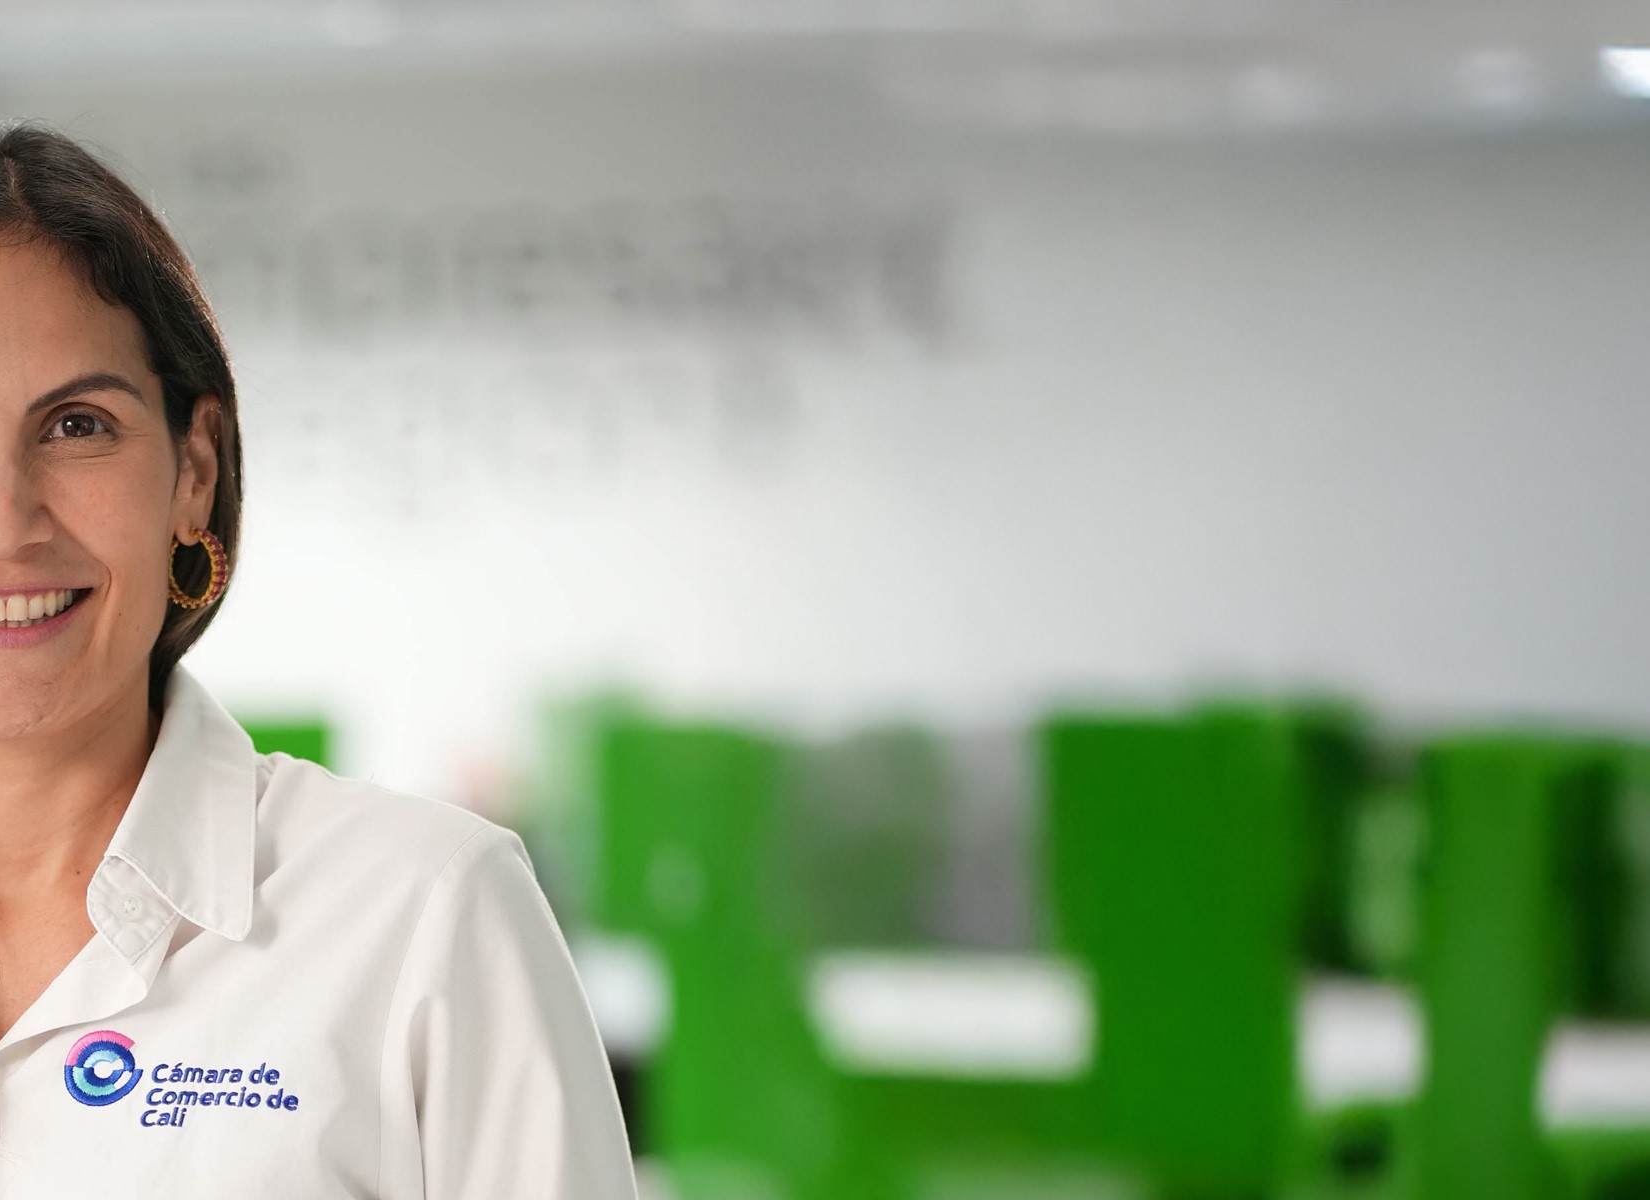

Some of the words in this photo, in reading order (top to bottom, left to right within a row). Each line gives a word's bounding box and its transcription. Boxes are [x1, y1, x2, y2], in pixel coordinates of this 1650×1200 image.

[151, 1062, 243, 1084] Cámara
[249, 1063, 280, 1085] de
[146, 1086, 261, 1108] Comercio
[266, 1088, 299, 1111] de
[140, 1107, 187, 1127] Cali
